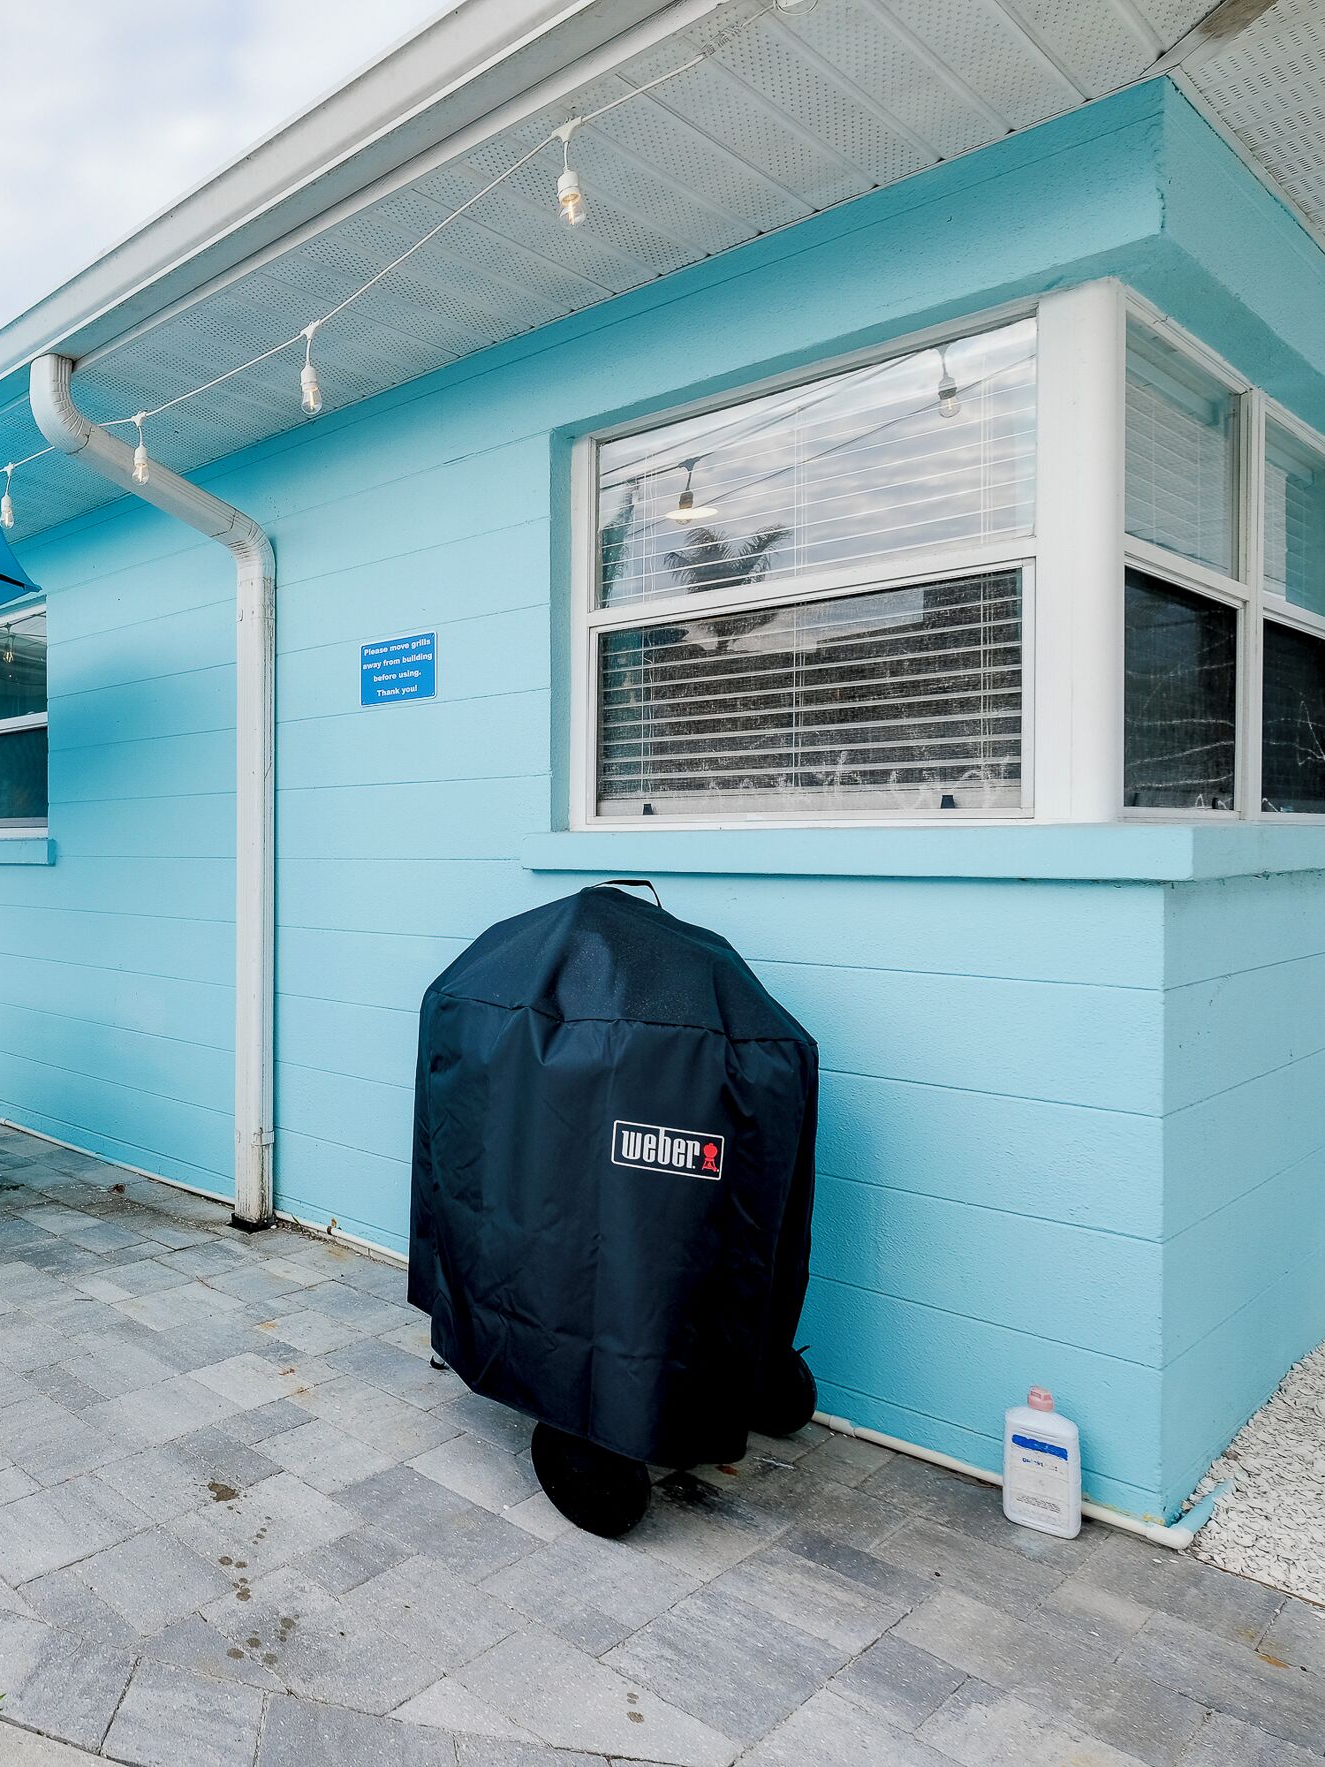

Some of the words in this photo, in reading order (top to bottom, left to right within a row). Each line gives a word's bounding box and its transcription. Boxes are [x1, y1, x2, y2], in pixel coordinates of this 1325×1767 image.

[364, 647, 388, 656] Please
[389, 643, 409, 652] move
[411, 638, 430, 649] grills
[362, 661, 381, 670] away
[383, 658, 400, 667] from
[402, 653, 432, 663] building
[373, 673, 397, 682] before
[398, 669, 422, 679] using.
[376, 687, 400, 697] Thank
[401, 684, 418, 695] you!
